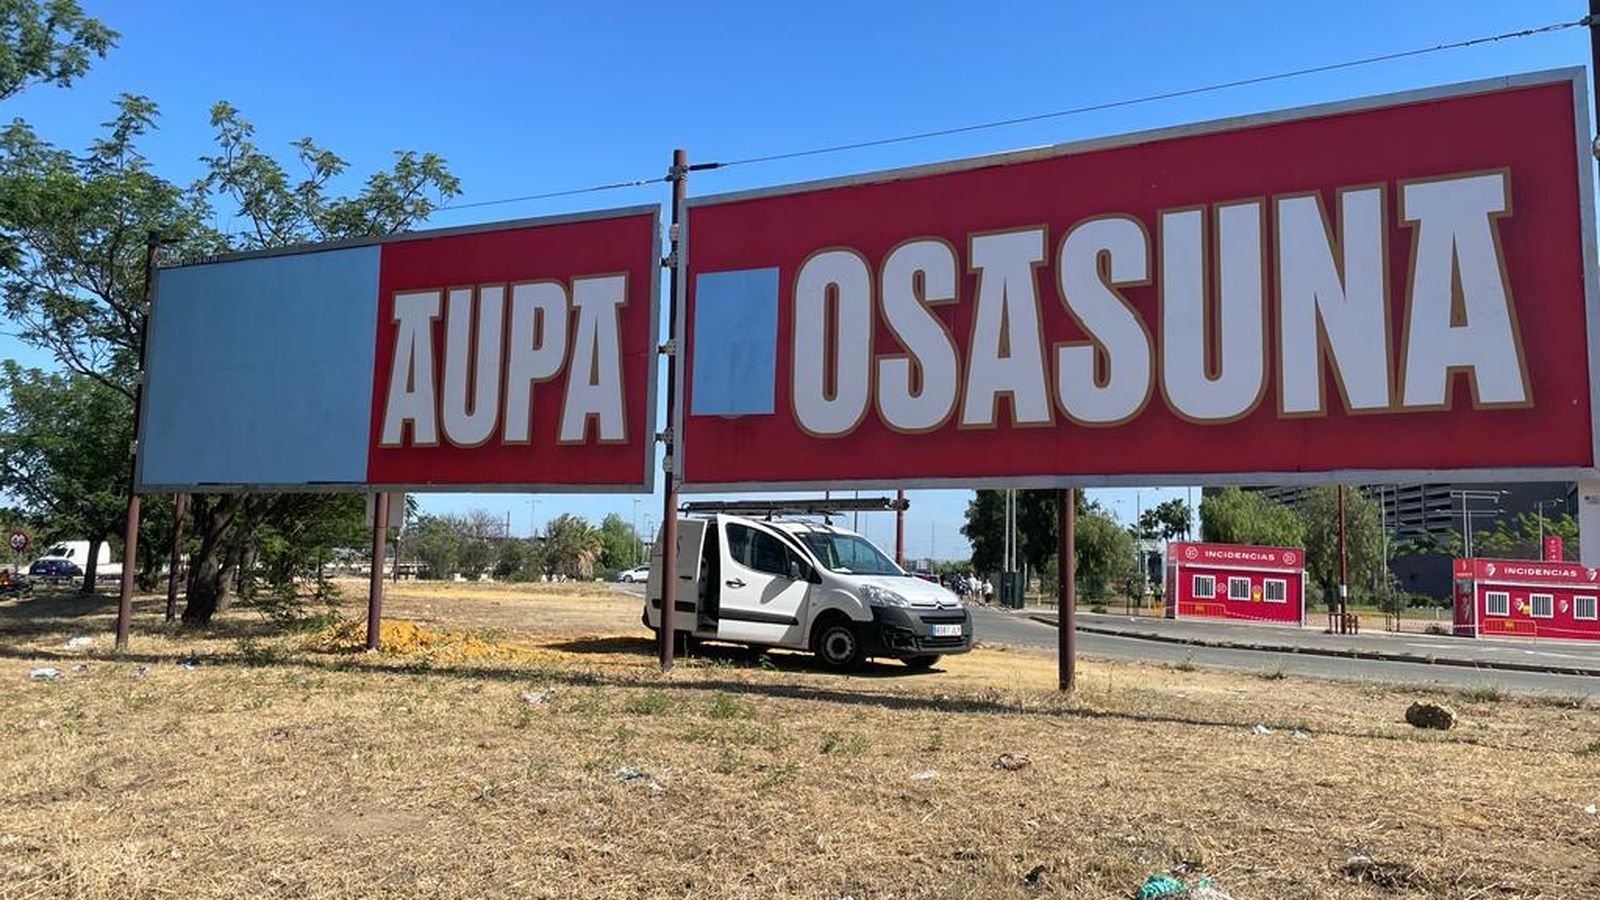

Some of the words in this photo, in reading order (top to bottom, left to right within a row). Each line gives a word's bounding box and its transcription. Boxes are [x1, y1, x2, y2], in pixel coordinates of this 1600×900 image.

[794, 167, 1534, 439] OSASUNA
[379, 272, 628, 448] AUPA
[1205, 550, 1275, 561] INCIDENCIAS
[1504, 567, 1577, 577] INCIDENCIAS
